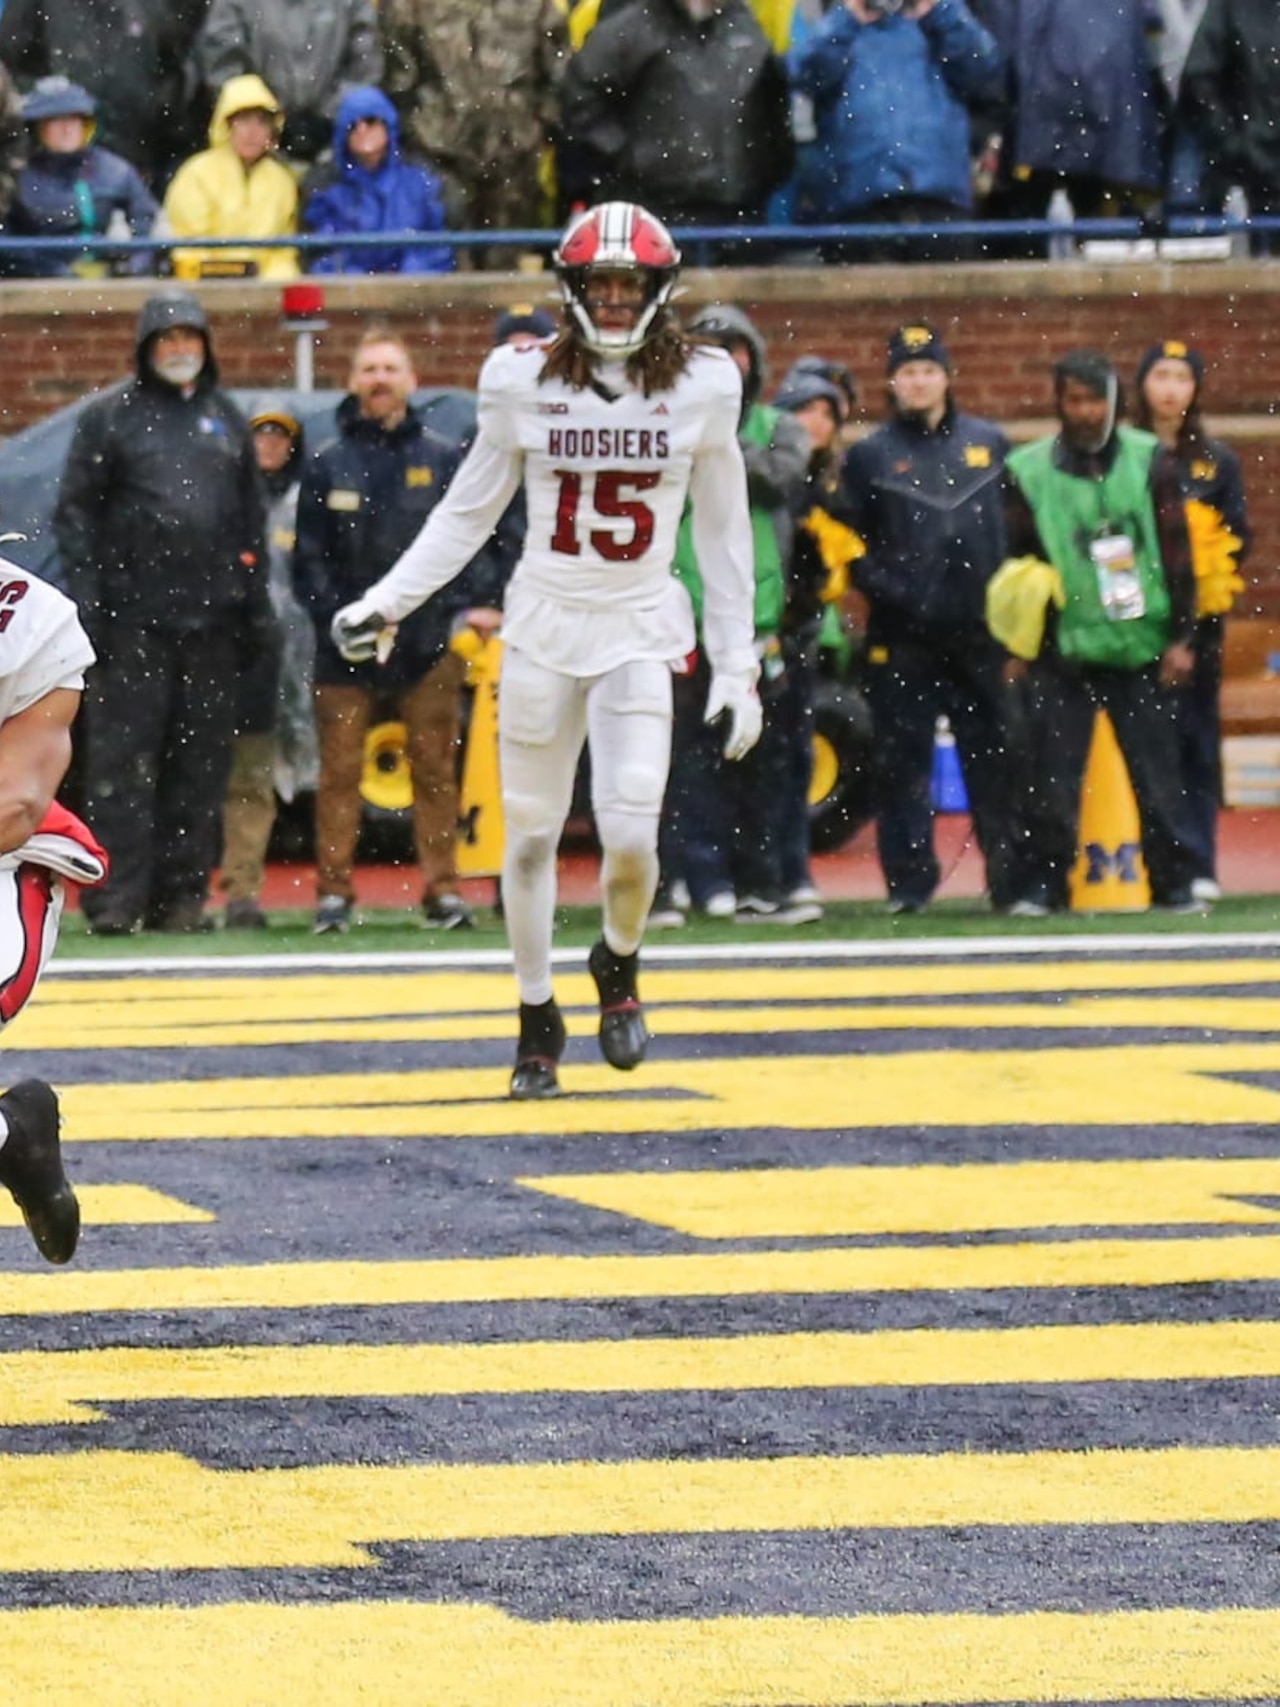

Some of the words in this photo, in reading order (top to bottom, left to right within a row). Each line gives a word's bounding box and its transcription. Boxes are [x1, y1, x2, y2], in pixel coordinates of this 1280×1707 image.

[549, 428, 669, 459] HOOSIERS
[551, 470, 662, 561] 15
[1085, 842, 1139, 884] M
